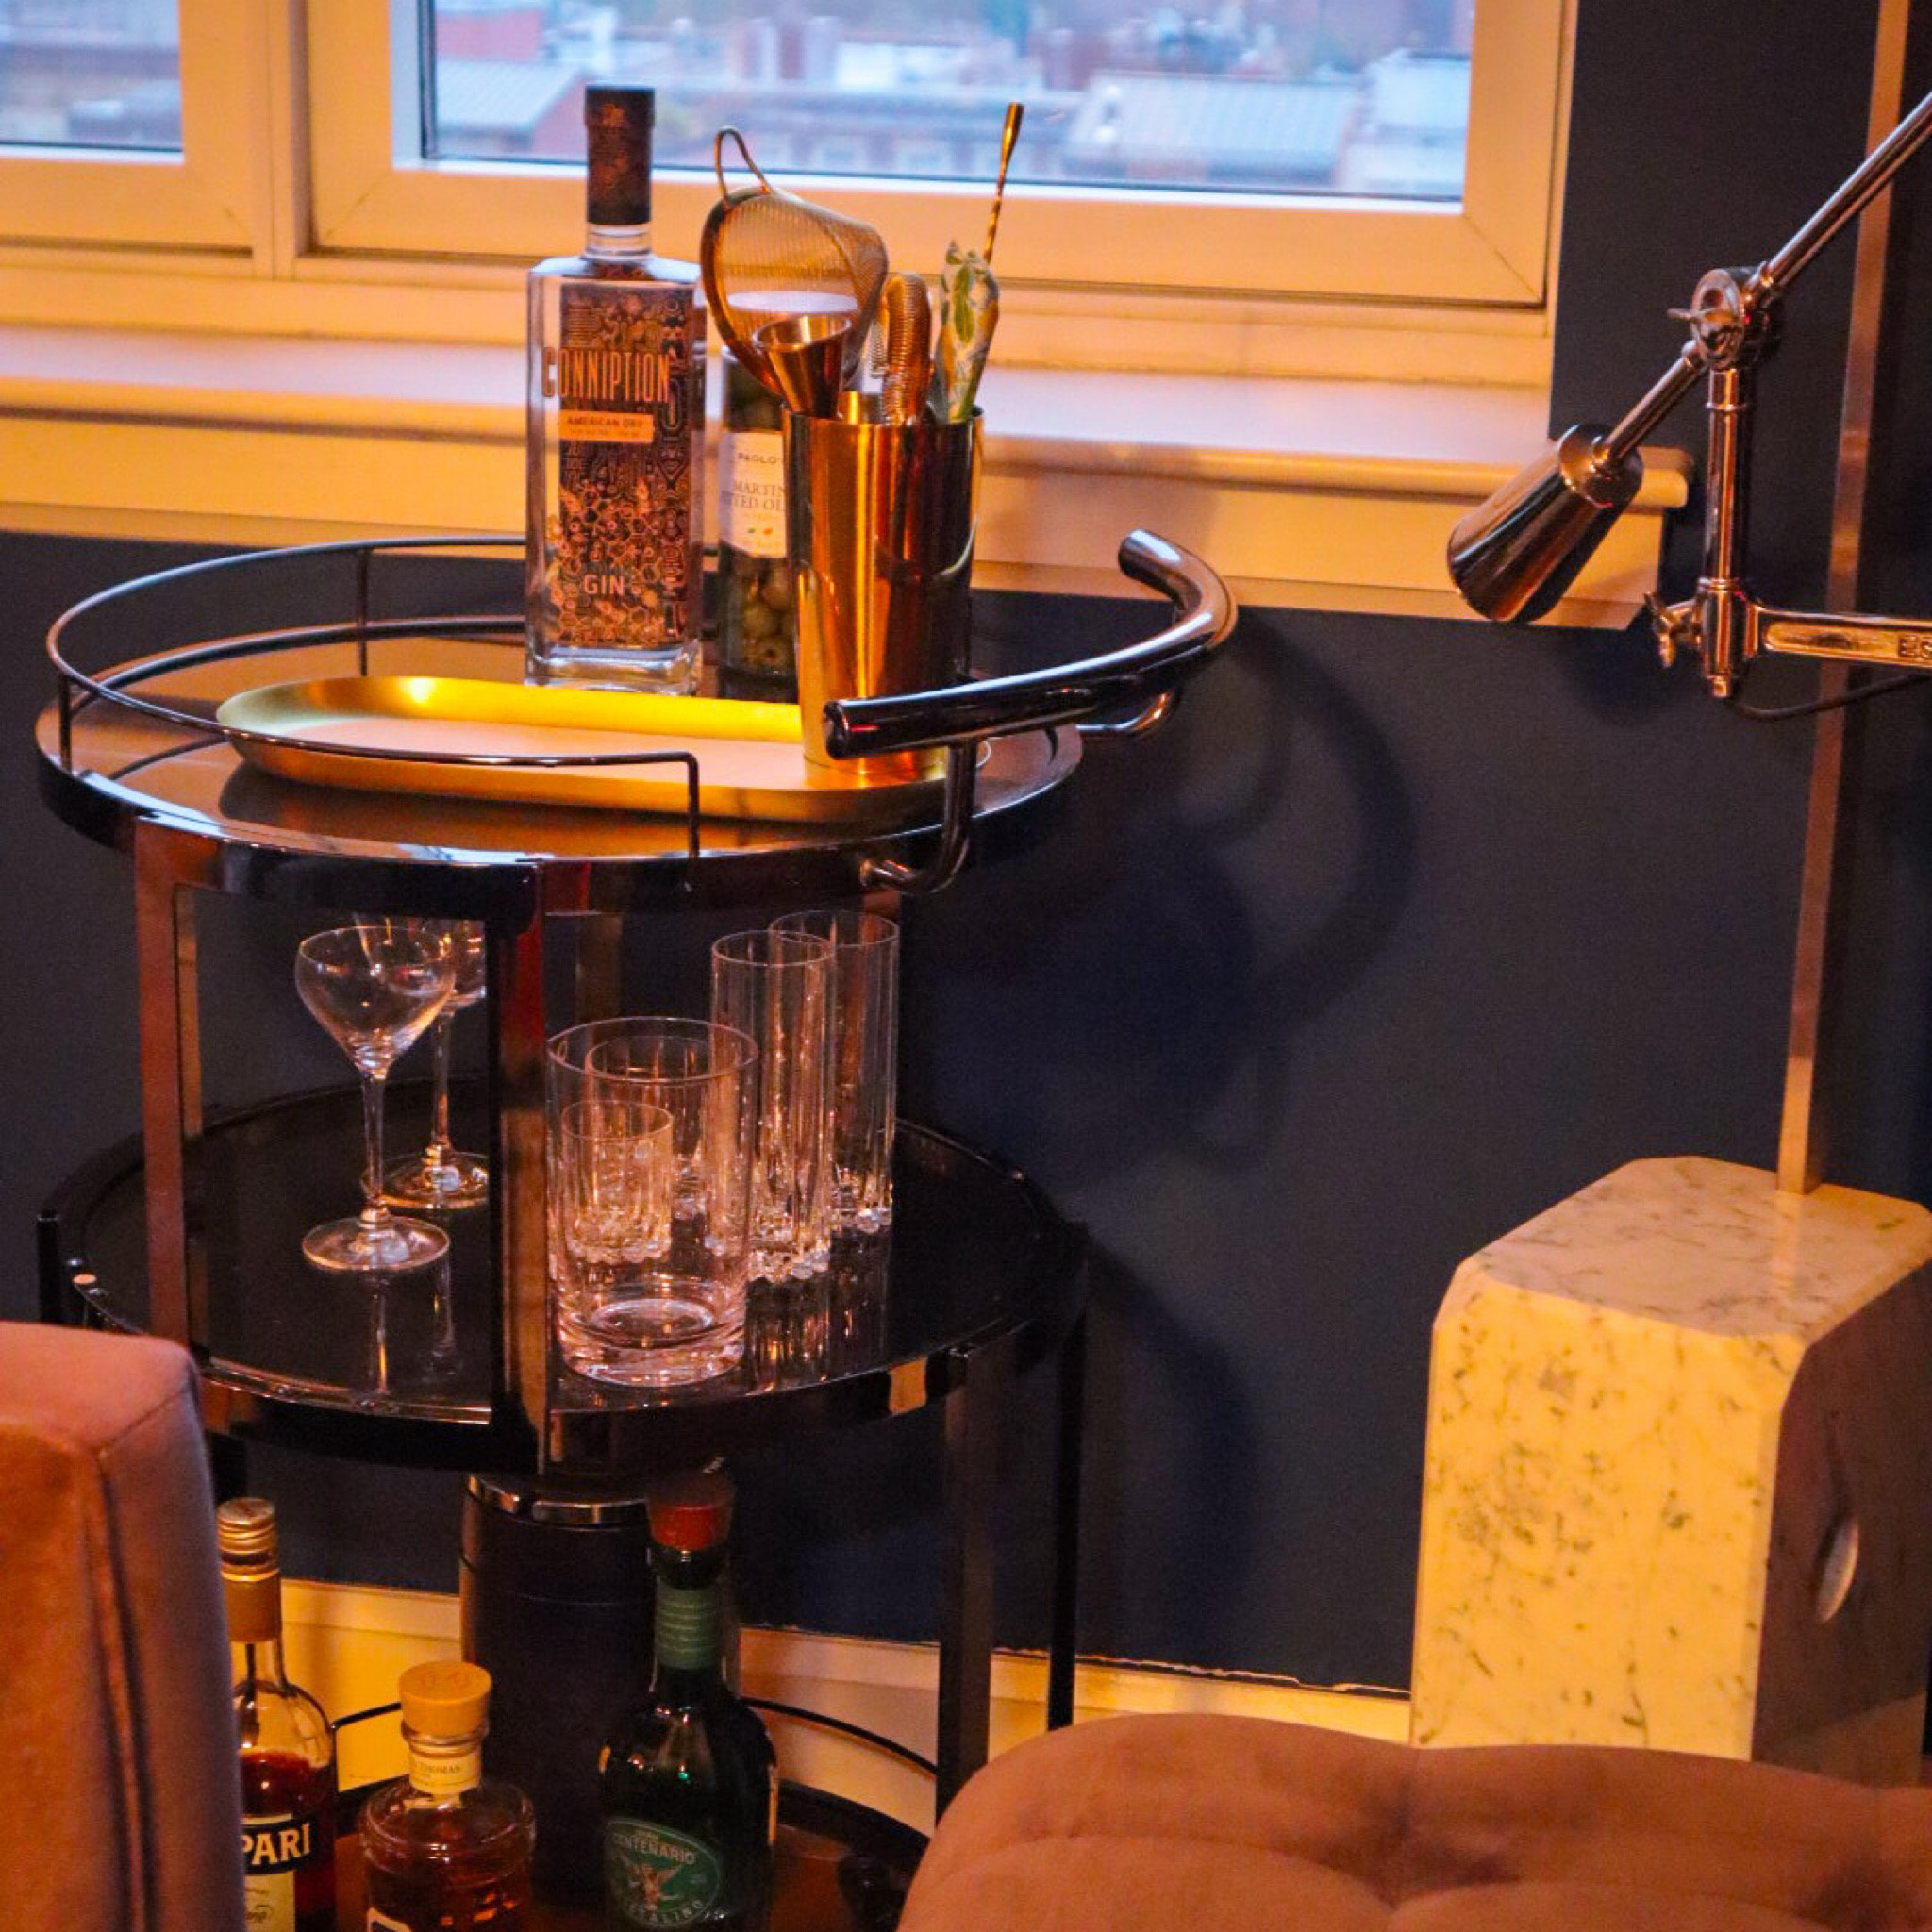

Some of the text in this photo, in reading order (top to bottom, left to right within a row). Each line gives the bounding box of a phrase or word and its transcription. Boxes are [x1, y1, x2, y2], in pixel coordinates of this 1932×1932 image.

[542, 347, 670, 403] CONNIPTION
[567, 416, 620, 426] AMERICAN
[583, 574, 625, 596] GIN
[242, 1822, 310, 1865] PARI
